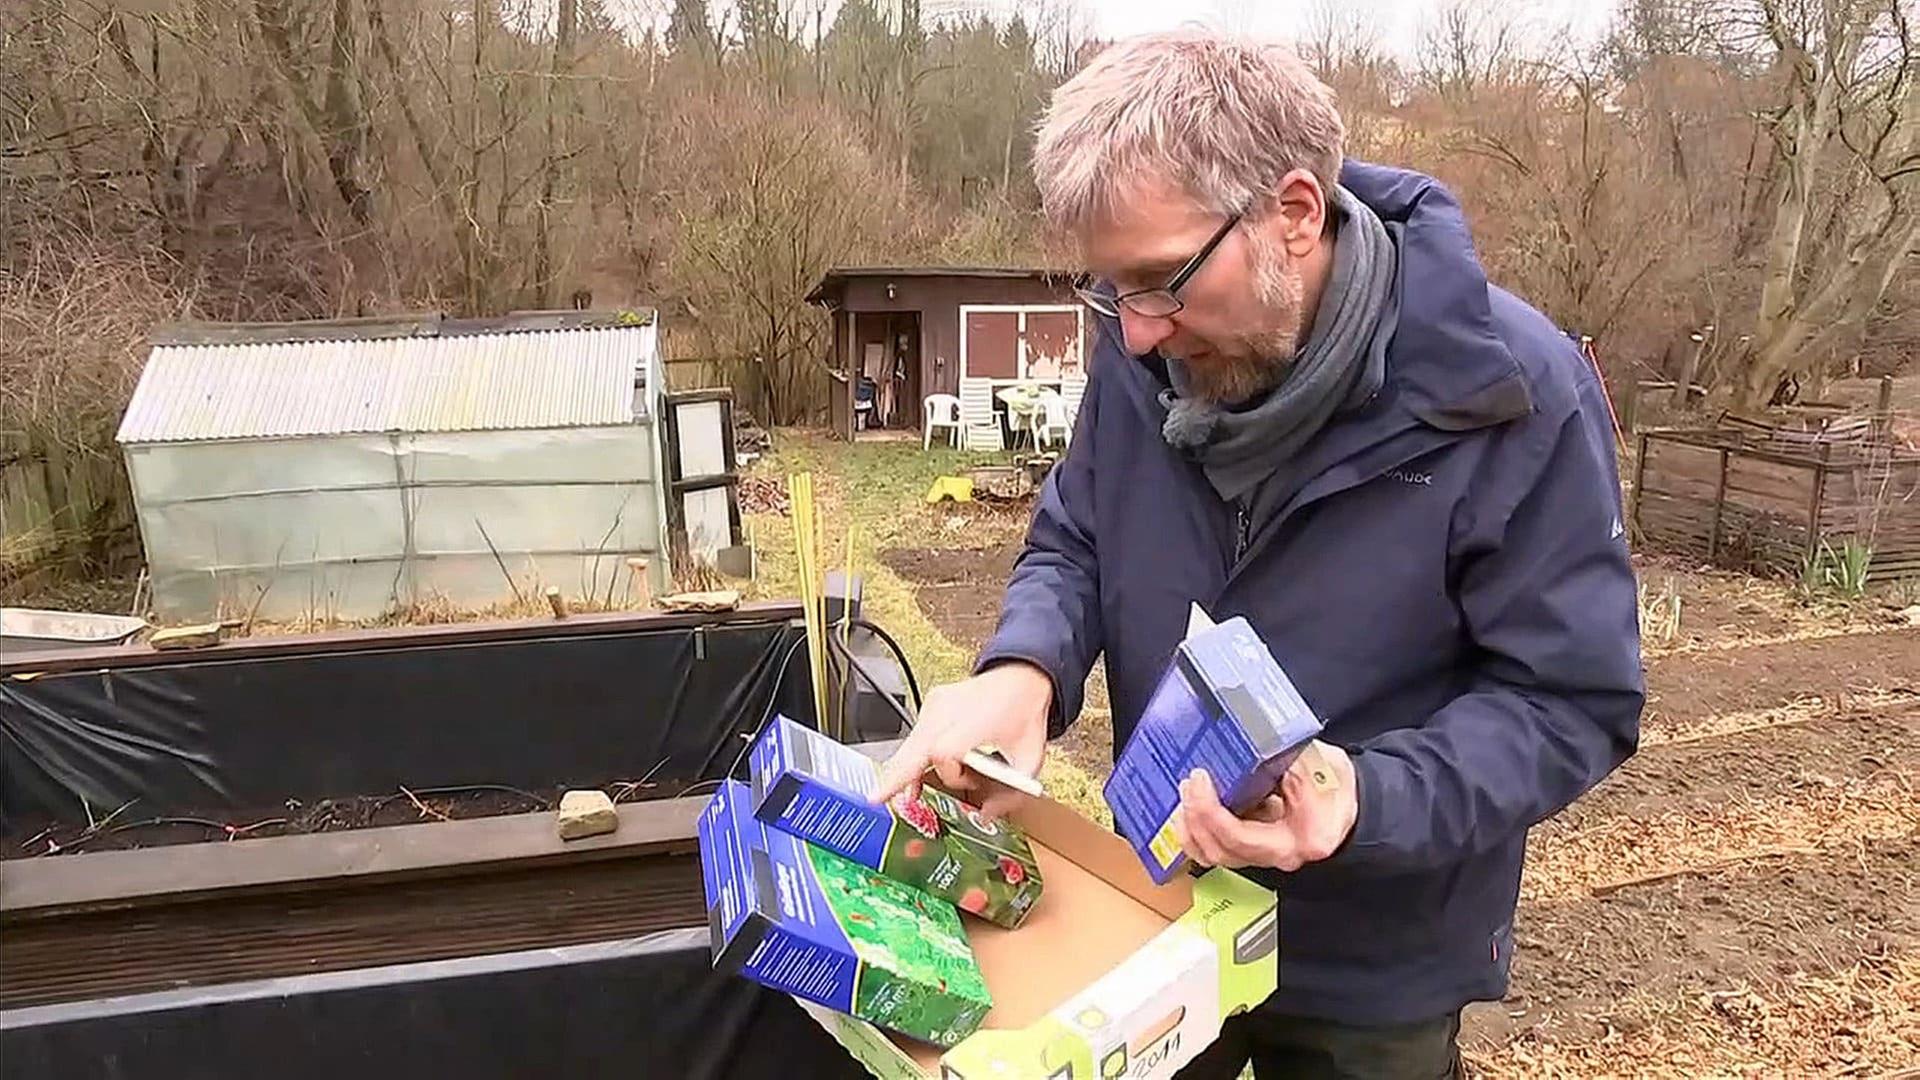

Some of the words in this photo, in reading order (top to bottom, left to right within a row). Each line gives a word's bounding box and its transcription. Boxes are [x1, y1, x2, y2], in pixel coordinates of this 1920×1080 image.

[938, 873, 954, 890] 100
[880, 1001, 895, 1016] 50
[1132, 1031, 1181, 1078] 2011
